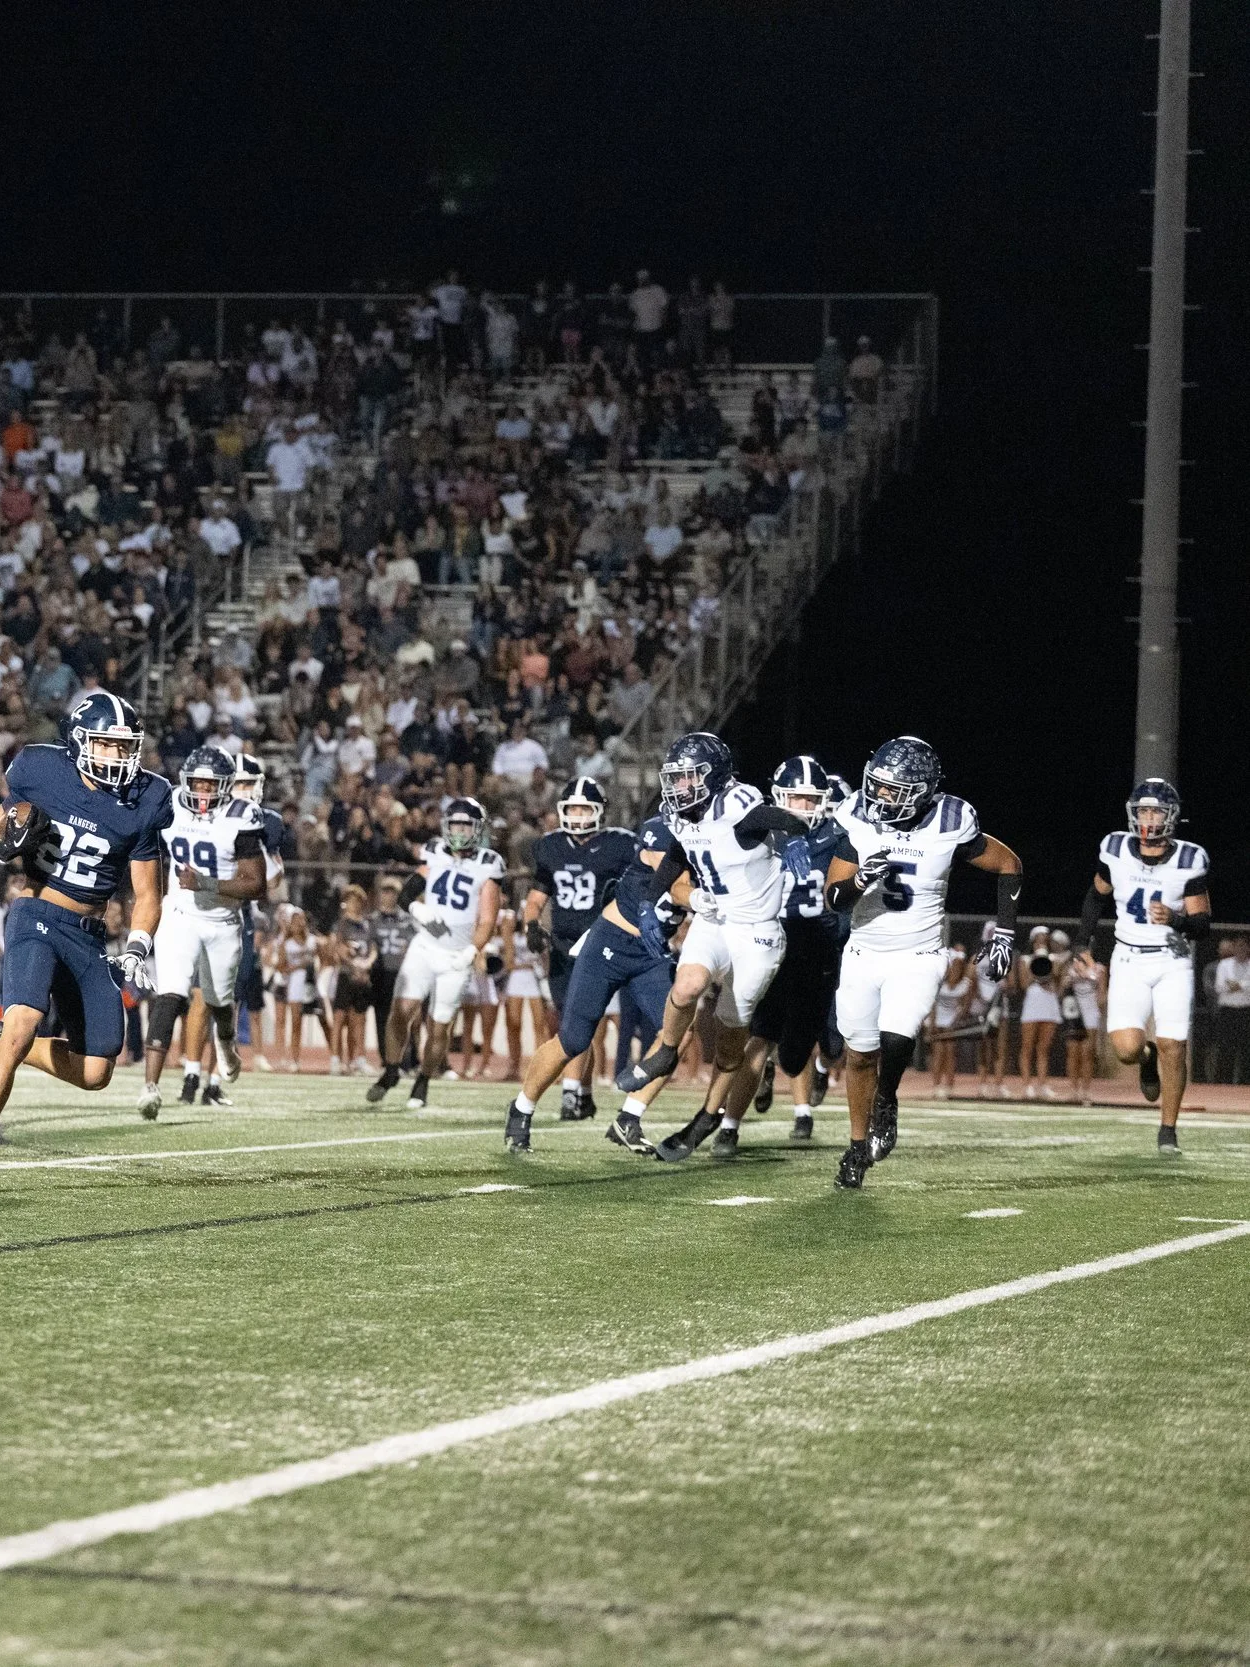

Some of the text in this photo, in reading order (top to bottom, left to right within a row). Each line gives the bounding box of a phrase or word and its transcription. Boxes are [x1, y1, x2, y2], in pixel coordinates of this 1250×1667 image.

[733, 788, 756, 810] 11
[68, 814, 98, 833] RANGERS
[35, 819, 111, 888] 22
[880, 844, 925, 858] CHAMPION
[431, 869, 474, 911] 45
[553, 870, 596, 911] 68
[688, 850, 730, 895] 11
[882, 860, 917, 912] 5
